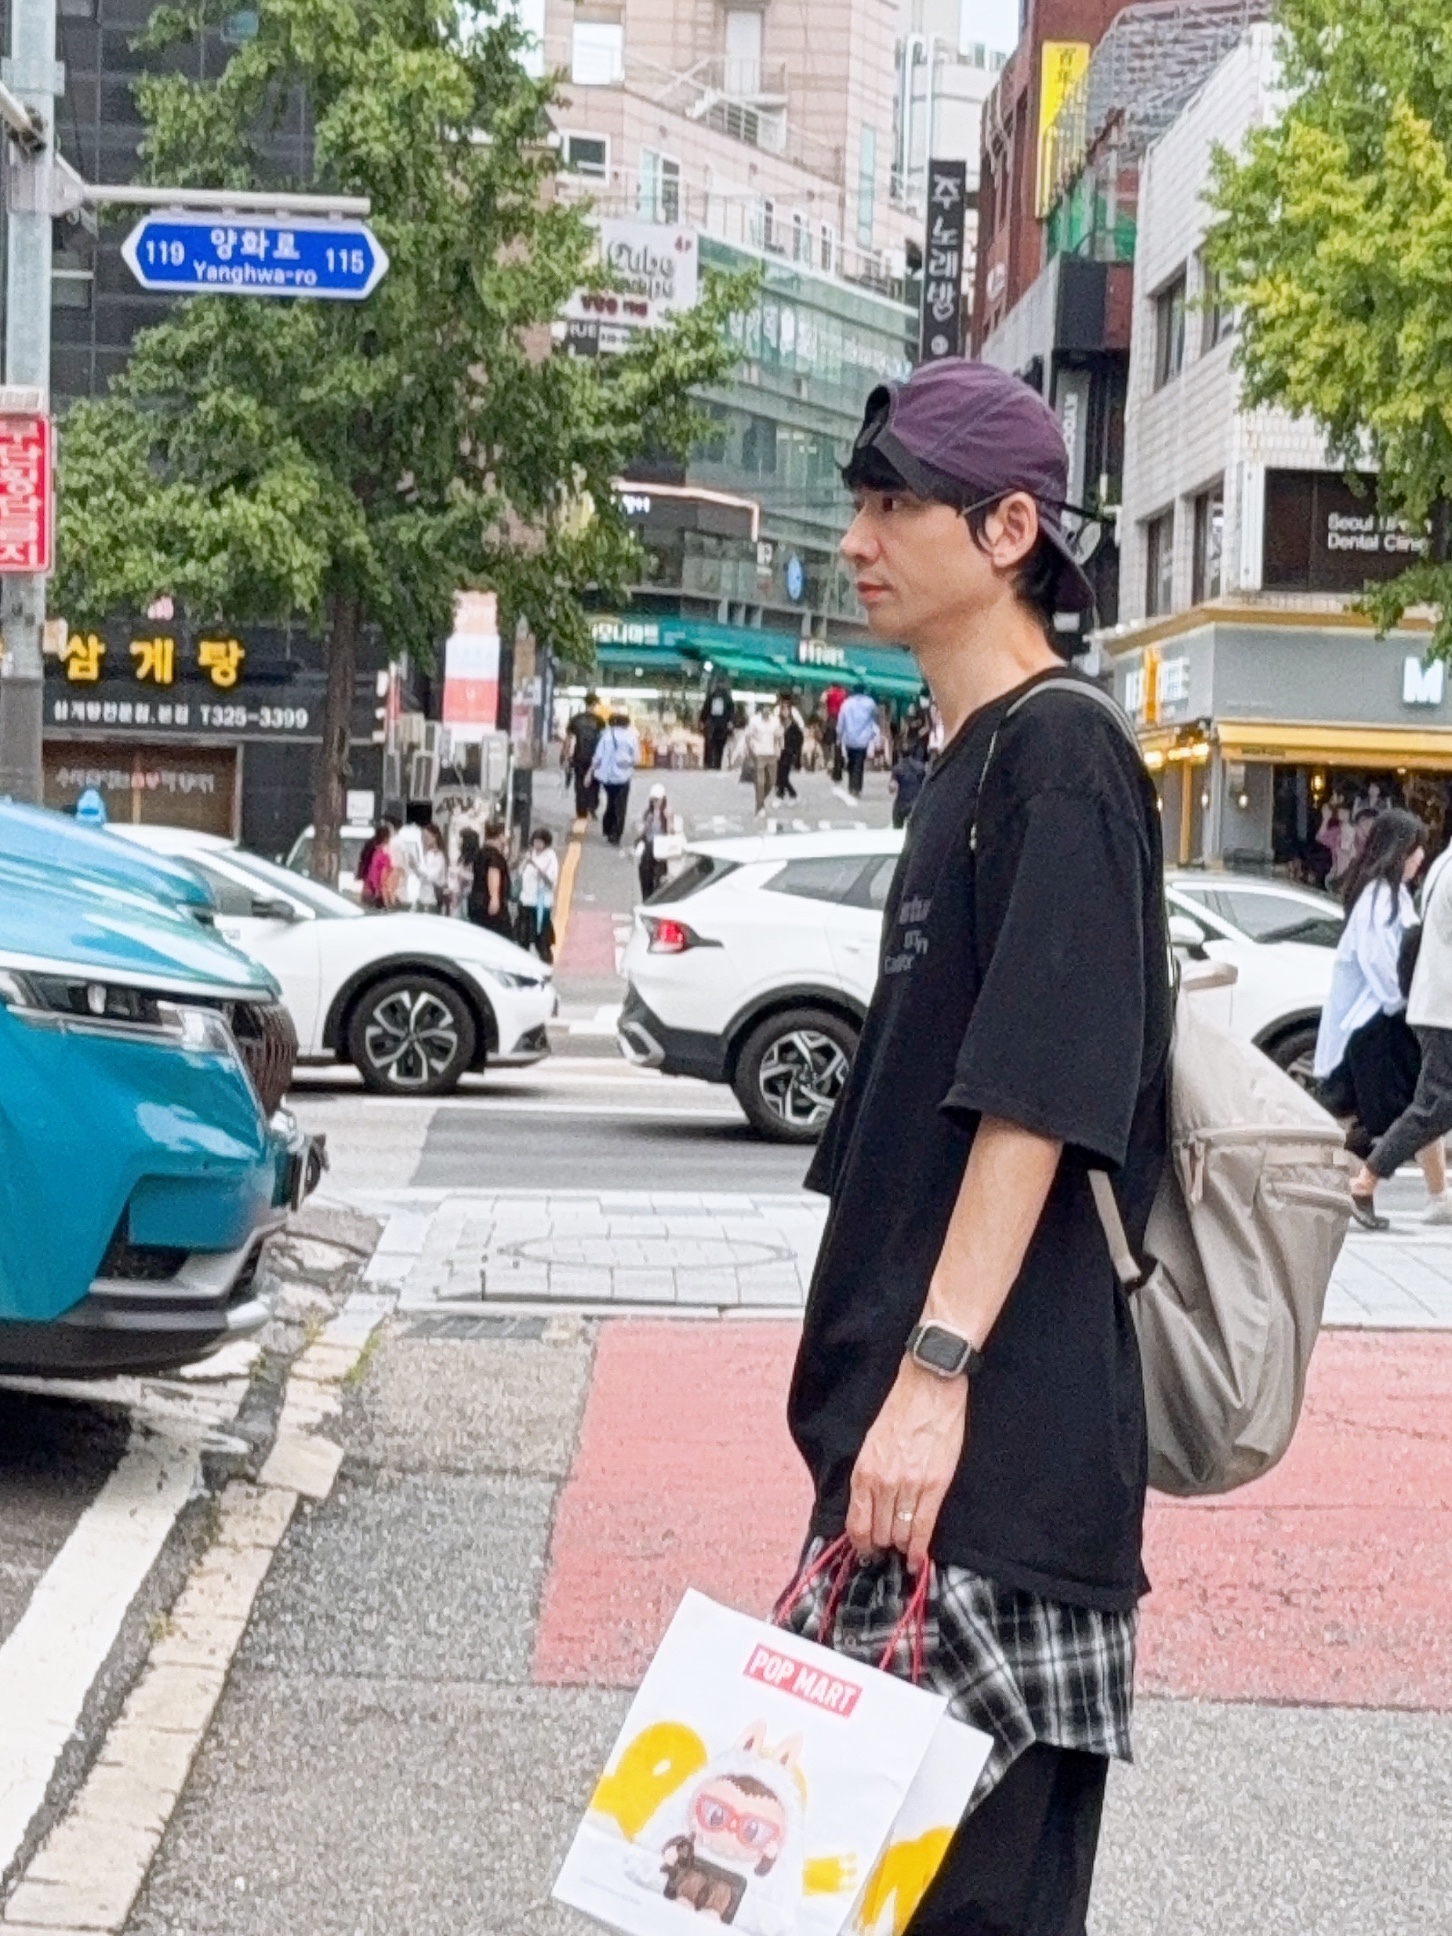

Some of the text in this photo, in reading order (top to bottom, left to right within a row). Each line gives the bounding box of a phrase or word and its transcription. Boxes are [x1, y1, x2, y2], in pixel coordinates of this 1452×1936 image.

[146, 240, 185, 267] 119
[210, 228, 300, 261] 양화로
[193, 259, 318, 286] Yanghwa-ro
[325, 247, 364, 275] 115
[1328, 512, 1374, 532] Seoul
[1328, 532, 1379, 552] Dental
[749, 1648, 858, 1712] POP MART
